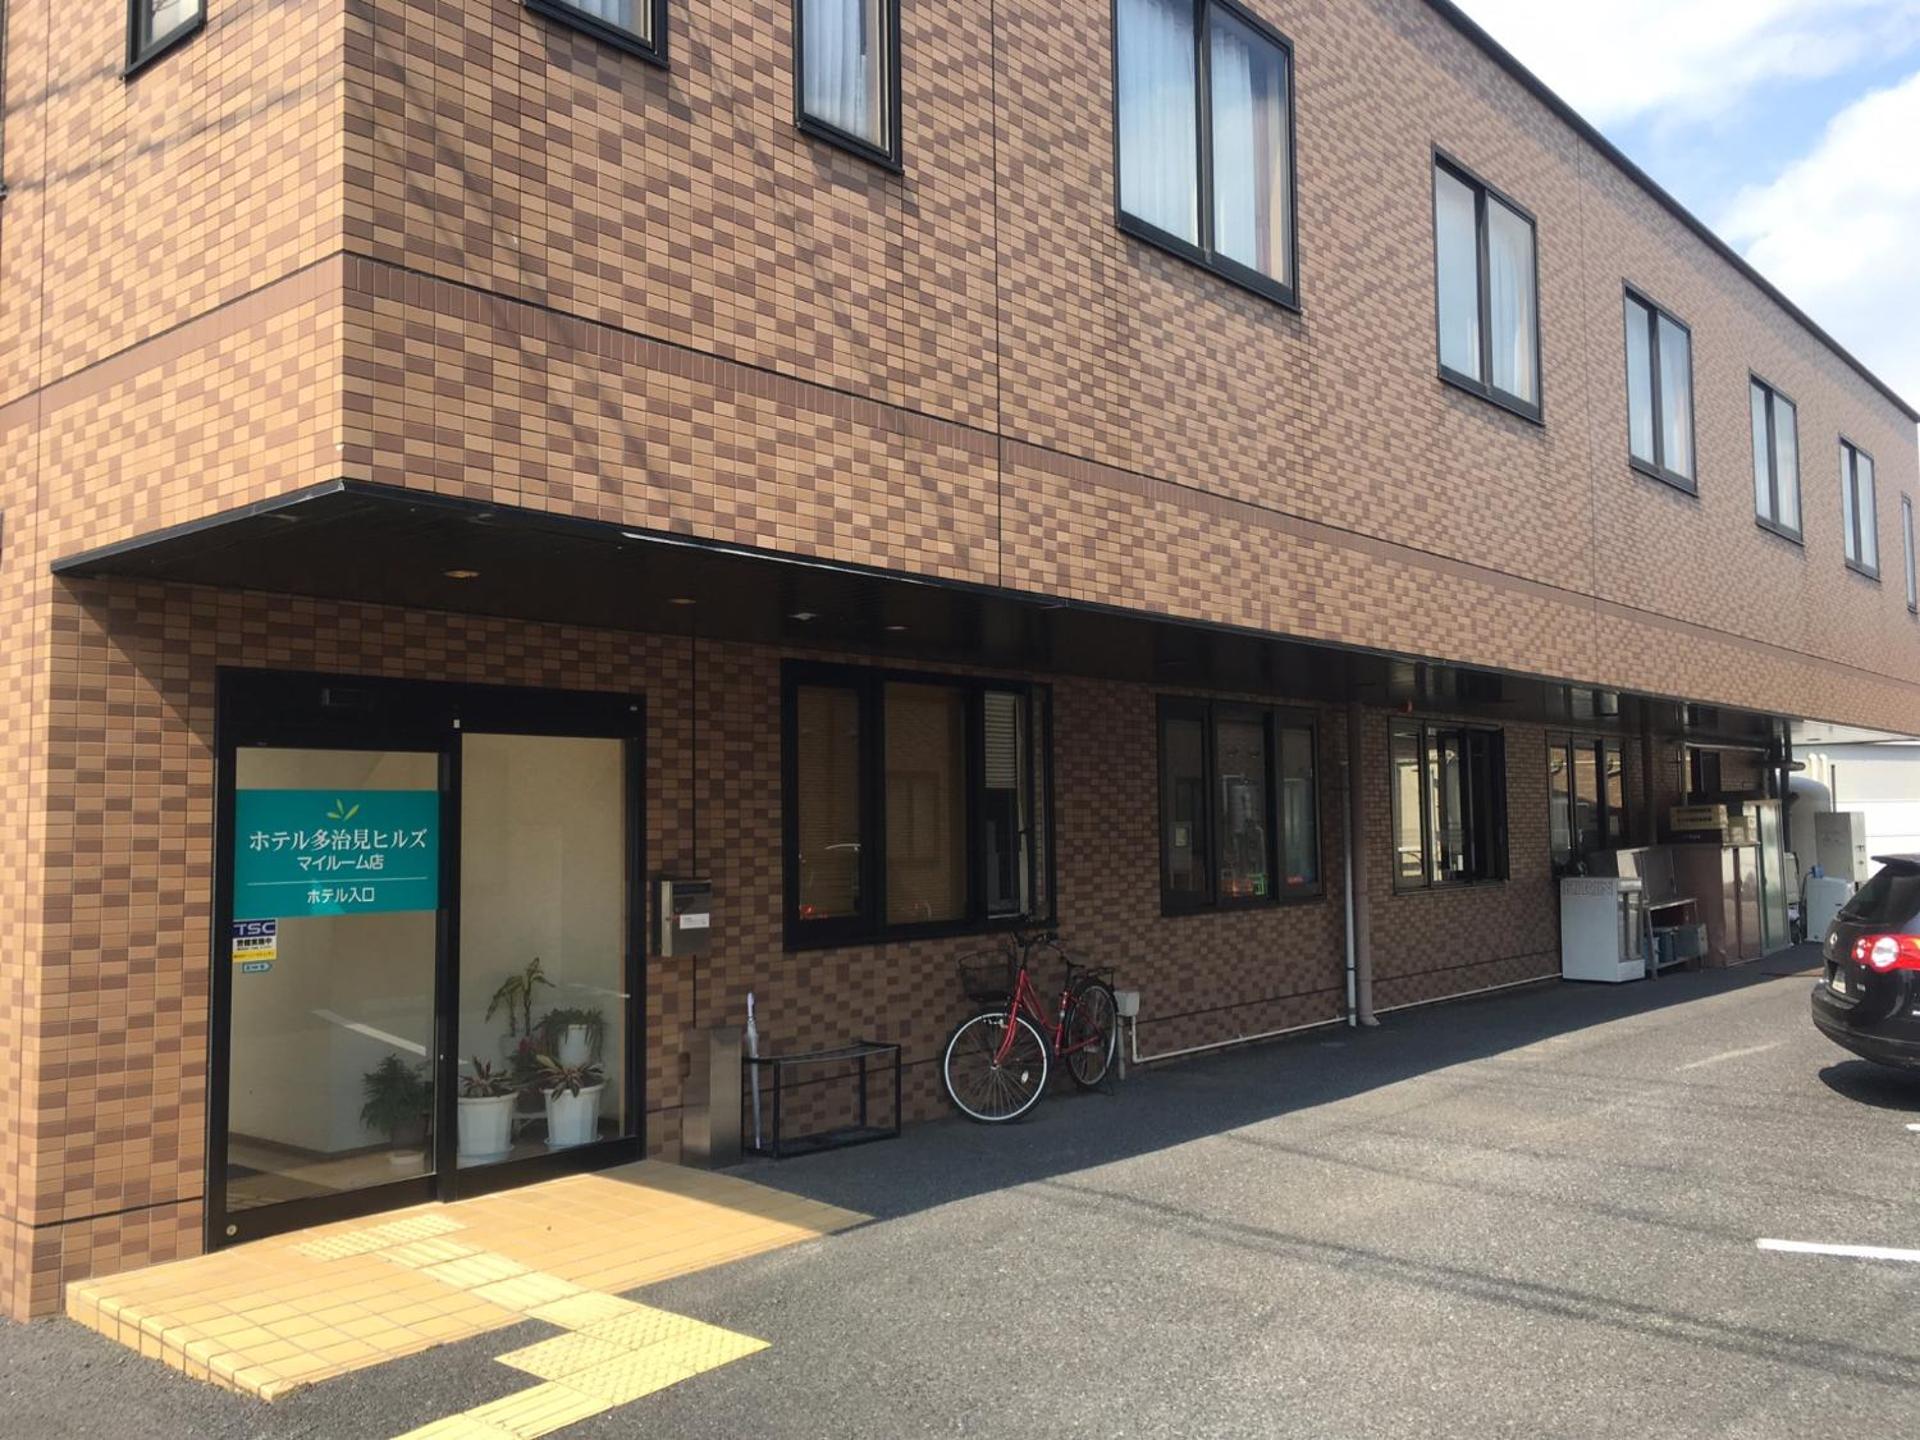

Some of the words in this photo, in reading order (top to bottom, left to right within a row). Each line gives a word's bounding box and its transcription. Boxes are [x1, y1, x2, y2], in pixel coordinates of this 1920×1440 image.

[250, 829, 427, 850] ホテル多治見ヒルズ
[297, 854, 384, 871] マイルーム店
[307, 887, 374, 903] ホテル入口
[233, 922, 275, 935] TSC
